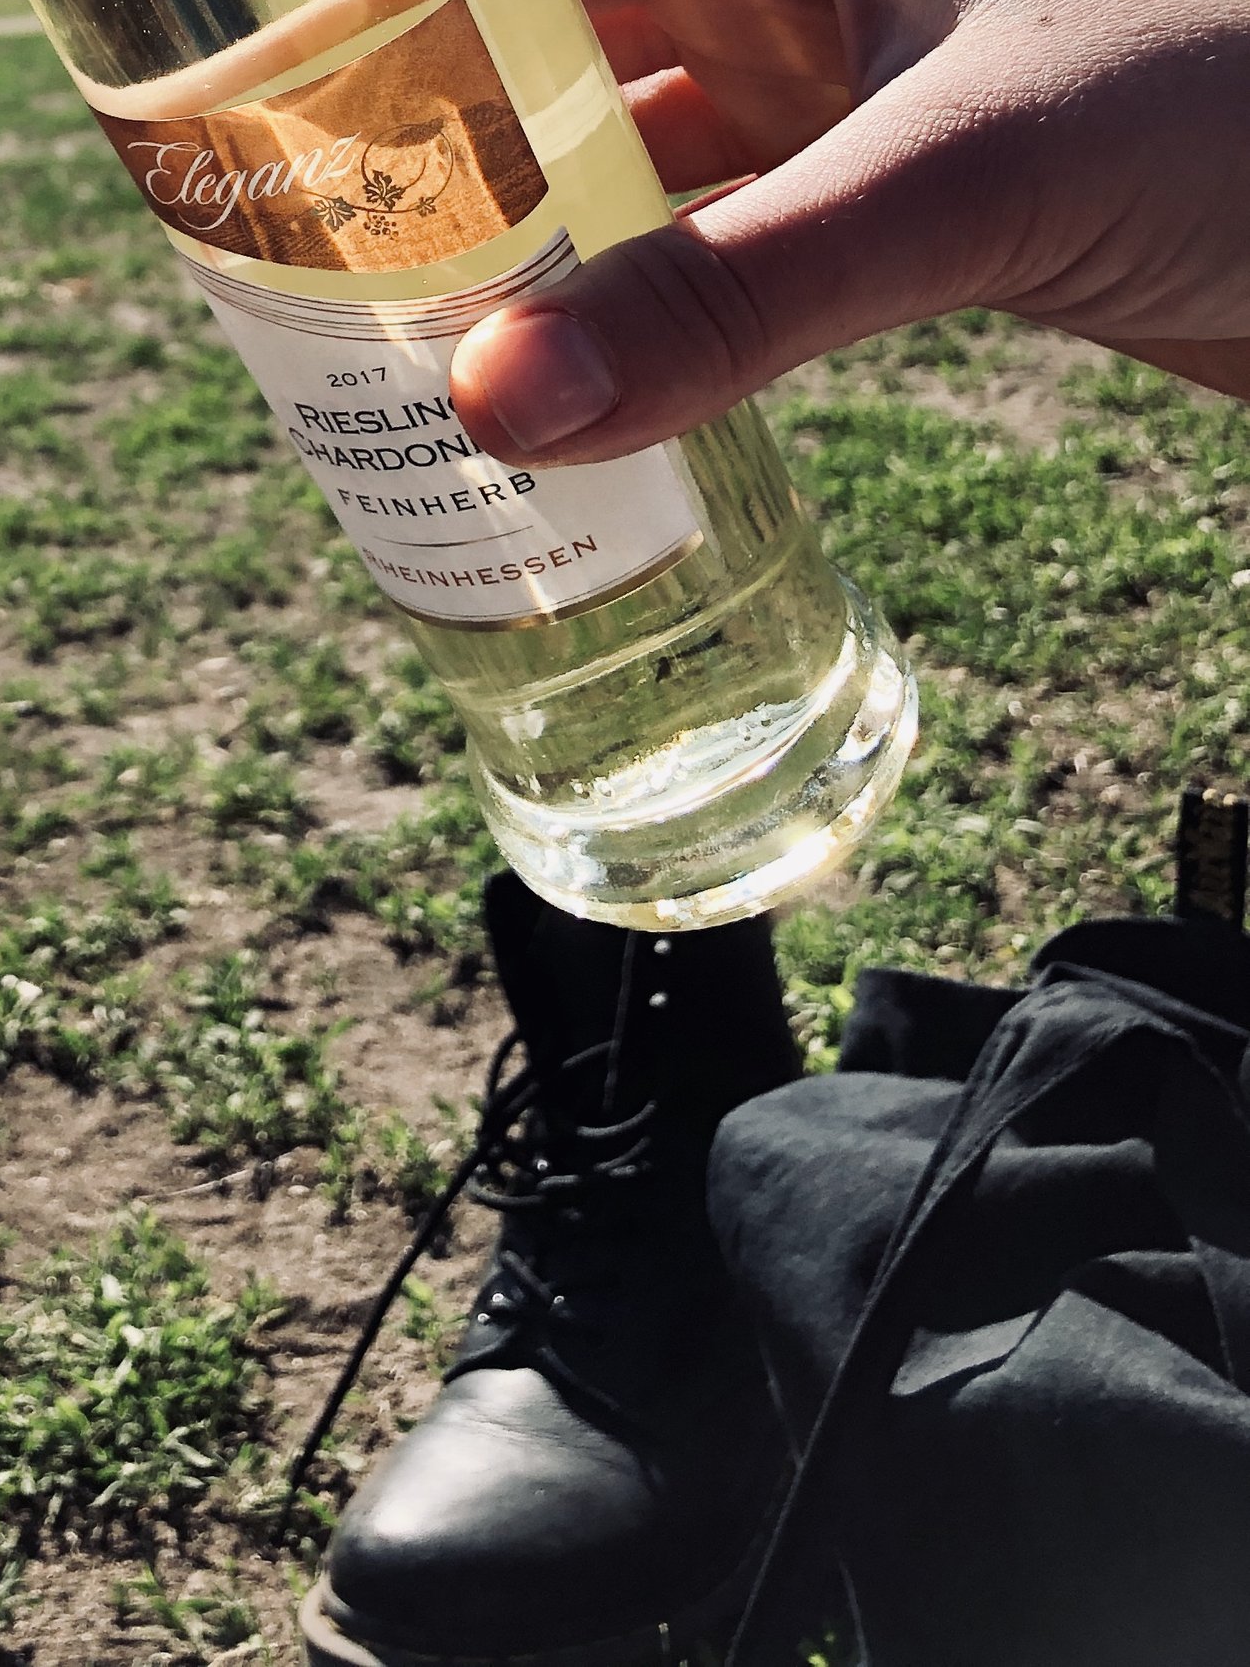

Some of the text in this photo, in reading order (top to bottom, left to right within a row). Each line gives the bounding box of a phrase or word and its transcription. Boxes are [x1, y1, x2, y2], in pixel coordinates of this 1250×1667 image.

[127, 132, 361, 231] Eleganz
[326, 367, 386, 387] 2017
[293, 395, 456, 434] RIESLIN
[288, 427, 484, 471] CHARDON
[337, 471, 536, 517] FEINHERB
[361, 534, 598, 587] RHEINHESSEN
